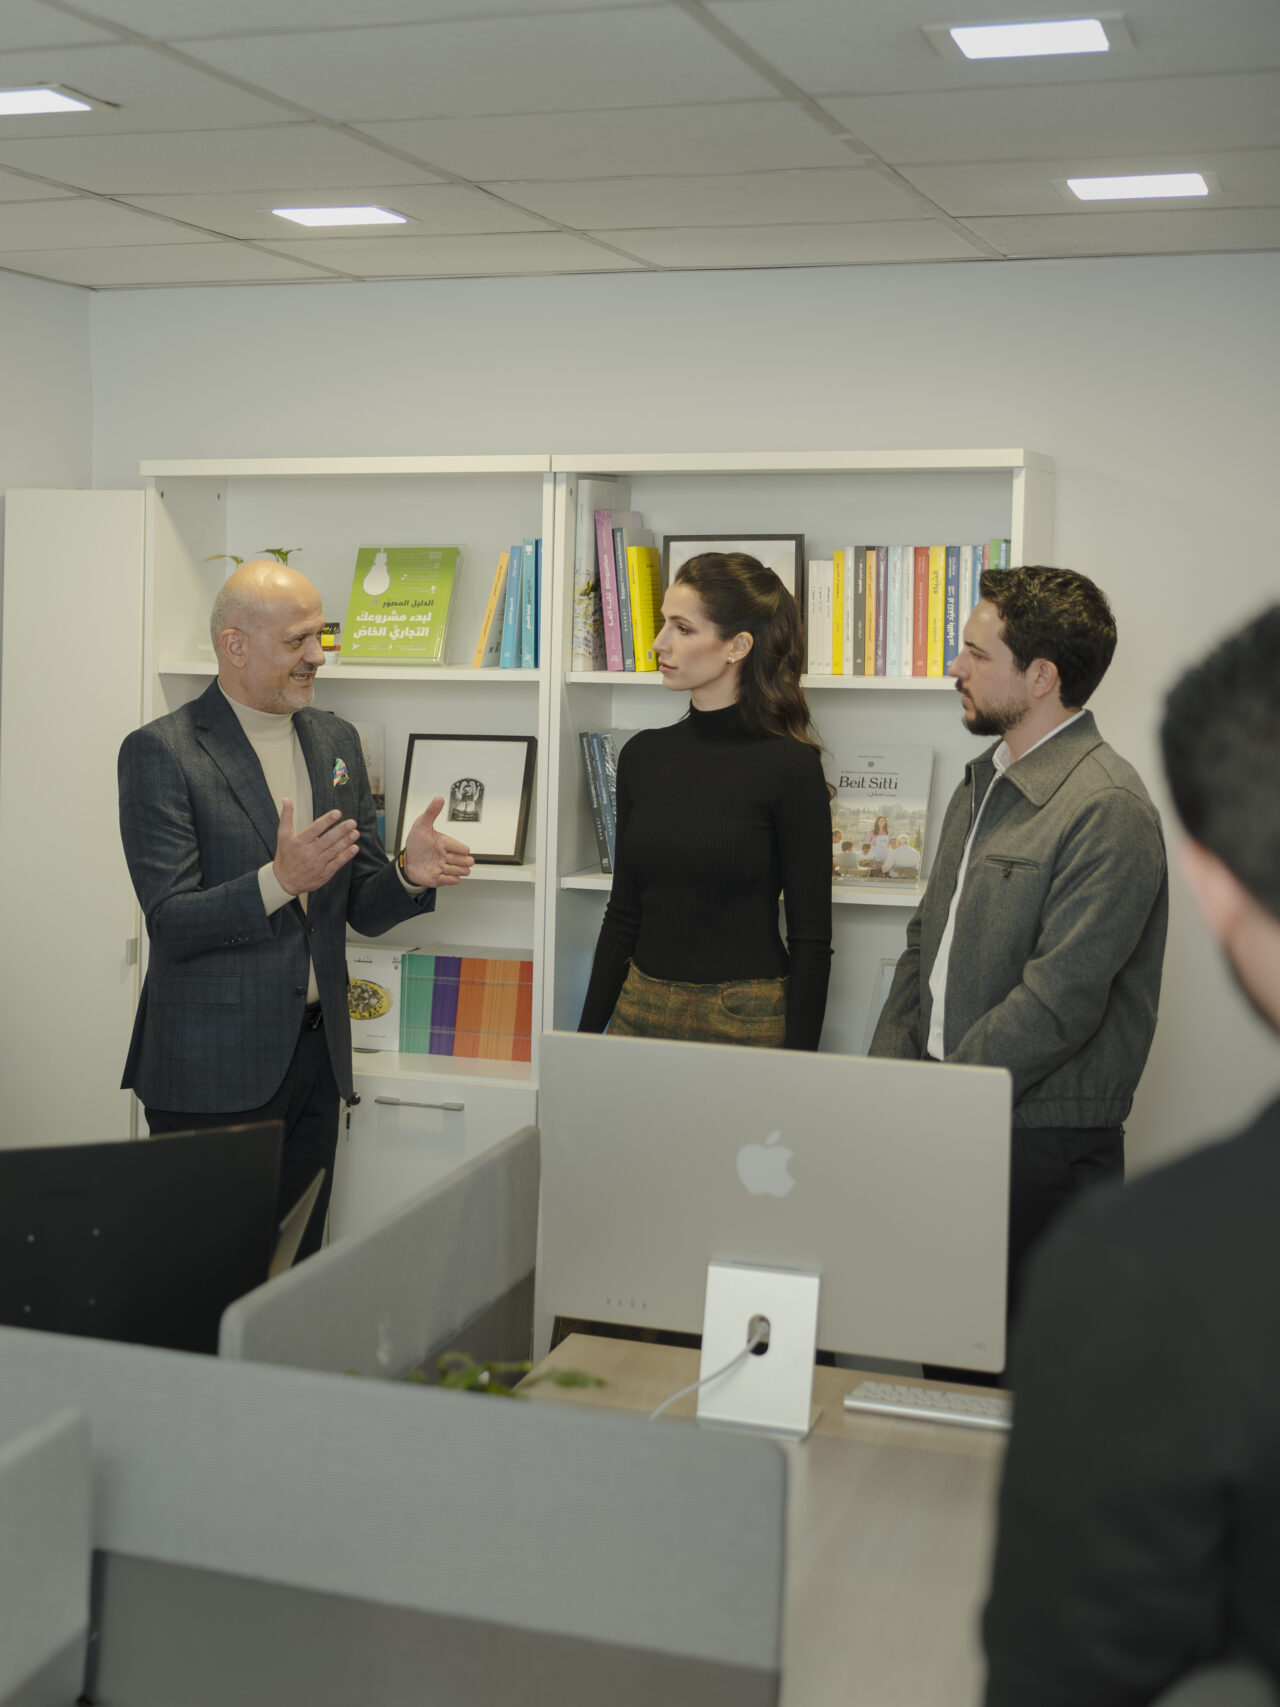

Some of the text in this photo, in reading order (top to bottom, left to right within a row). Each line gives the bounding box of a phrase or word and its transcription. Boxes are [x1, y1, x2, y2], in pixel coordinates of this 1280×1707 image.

[411, 599, 434, 608] الدليل
[410, 611, 432, 624] لبدء
[838, 775, 898, 789] Beit Sitti
